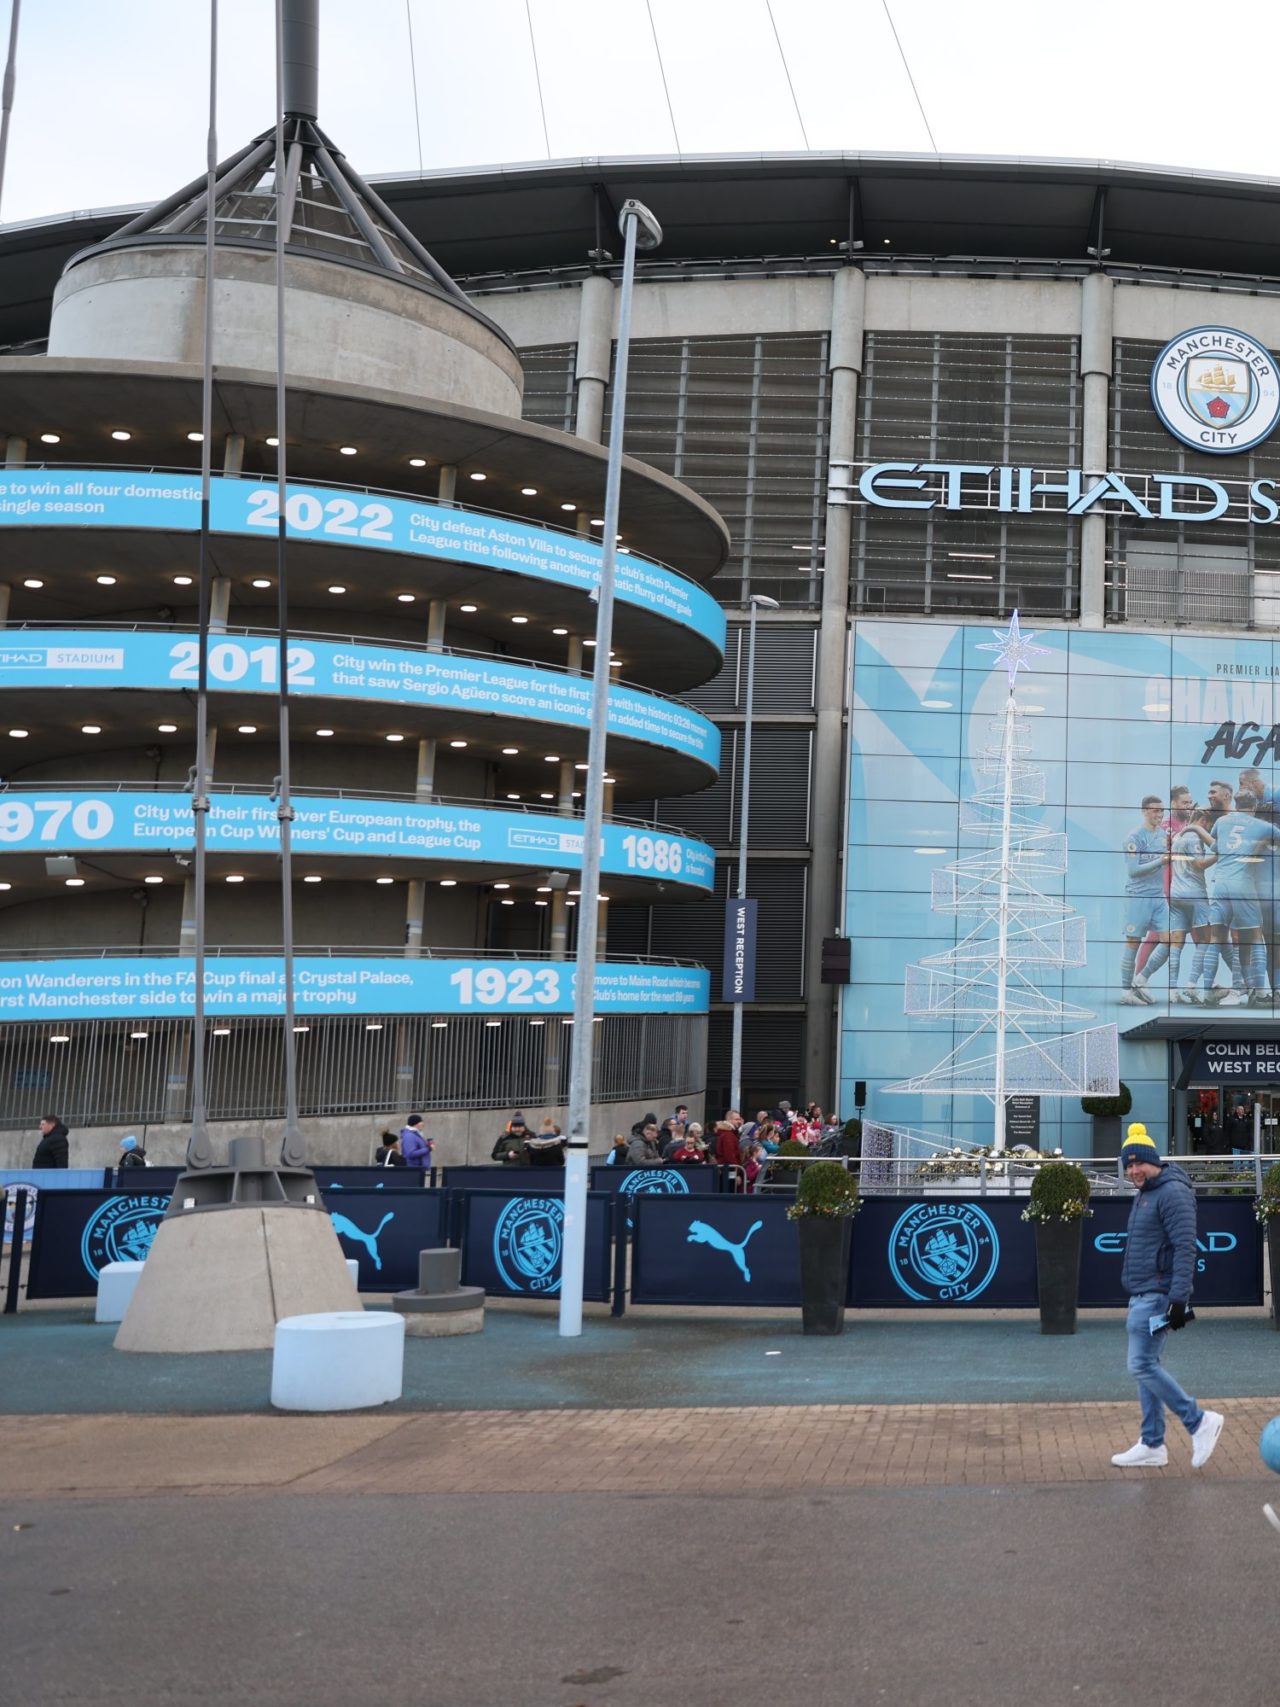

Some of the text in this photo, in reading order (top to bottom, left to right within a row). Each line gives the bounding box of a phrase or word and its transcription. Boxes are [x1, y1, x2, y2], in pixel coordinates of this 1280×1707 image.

[1167, 335, 1270, 378] MANCHESTER
[1199, 431, 1238, 444] CITY
[10, 482, 204, 501] to win all four domestic
[858, 462, 1230, 521] ETIHAD
[44, 501, 105, 513] season
[247, 489, 394, 542] 2022
[410, 513, 440, 531] City
[442, 519, 487, 538] defeat
[488, 529, 526, 547] Aston
[528, 536, 554, 554] Villa
[555, 544, 567, 557] to
[568, 549, 604, 568] secure
[410, 529, 462, 550] League
[463, 539, 490, 555] title
[492, 545, 550, 570] following
[550, 559, 592, 579] another
[57, 653, 115, 664] STADIUM
[169, 641, 316, 686] 2012
[1216, 663, 1260, 676] PREMIER
[332, 654, 366, 671] City
[368, 658, 396, 673] win
[398, 661, 423, 676] the
[425, 663, 481, 683] Premier
[483, 671, 529, 689] League
[530, 678, 547, 693] for
[548, 682, 567, 696] the
[569, 685, 590, 701] first
[614, 698, 634, 713] with
[332, 671, 366, 686] that
[368, 677, 400, 690] saw
[403, 678, 449, 697] Sergio
[451, 683, 500, 702] Agüero
[502, 694, 536, 708] score
[537, 698, 552, 710] an
[553, 700, 586, 716] iconic
[608, 710, 618, 722] in
[618, 714, 644, 729] added
[134, 804, 170, 820] City
[209, 805, 249, 820] their
[252, 806, 278, 821] firs
[293, 811, 326, 823] ever
[329, 811, 403, 829] European
[405, 815, 457, 832] trophy,
[459, 818, 481, 833] the
[134, 823, 482, 851] Europen Cup Winers' Cup and League Cup
[513, 834, 558, 846] ETIHAD
[1226, 825, 1246, 849] 5
[622, 834, 683, 874] 1986
[733, 906, 747, 994] WEST RECEPTION
[25, 970, 414, 988] Wanderers in the FA Cup final Crystal Palace,
[450, 968, 560, 1004] 1923
[594, 975, 619, 986] move
[620, 974, 629, 986] to
[629, 973, 652, 987] Maine
[28, 991, 136, 1008] Manchester
[139, 990, 176, 1005] side
[180, 991, 197, 1004] to
[203, 989, 233, 1004] win
[237, 991, 248, 1003] a
[303, 988, 357, 1005] trophy
[618, 990, 640, 1002] home
[1206, 1044, 1251, 1056] COLIN
[1207, 1061, 1252, 1073] WEST
[93, 1196, 171, 1239] MANCHEST
[501, 1198, 565, 1240] MANCHESTER
[898, 1204, 981, 1247] MANCHESTER
[979, 1236, 990, 1246] 94
[529, 1275, 553, 1290] CITY
[938, 1282, 970, 1299] CITY
